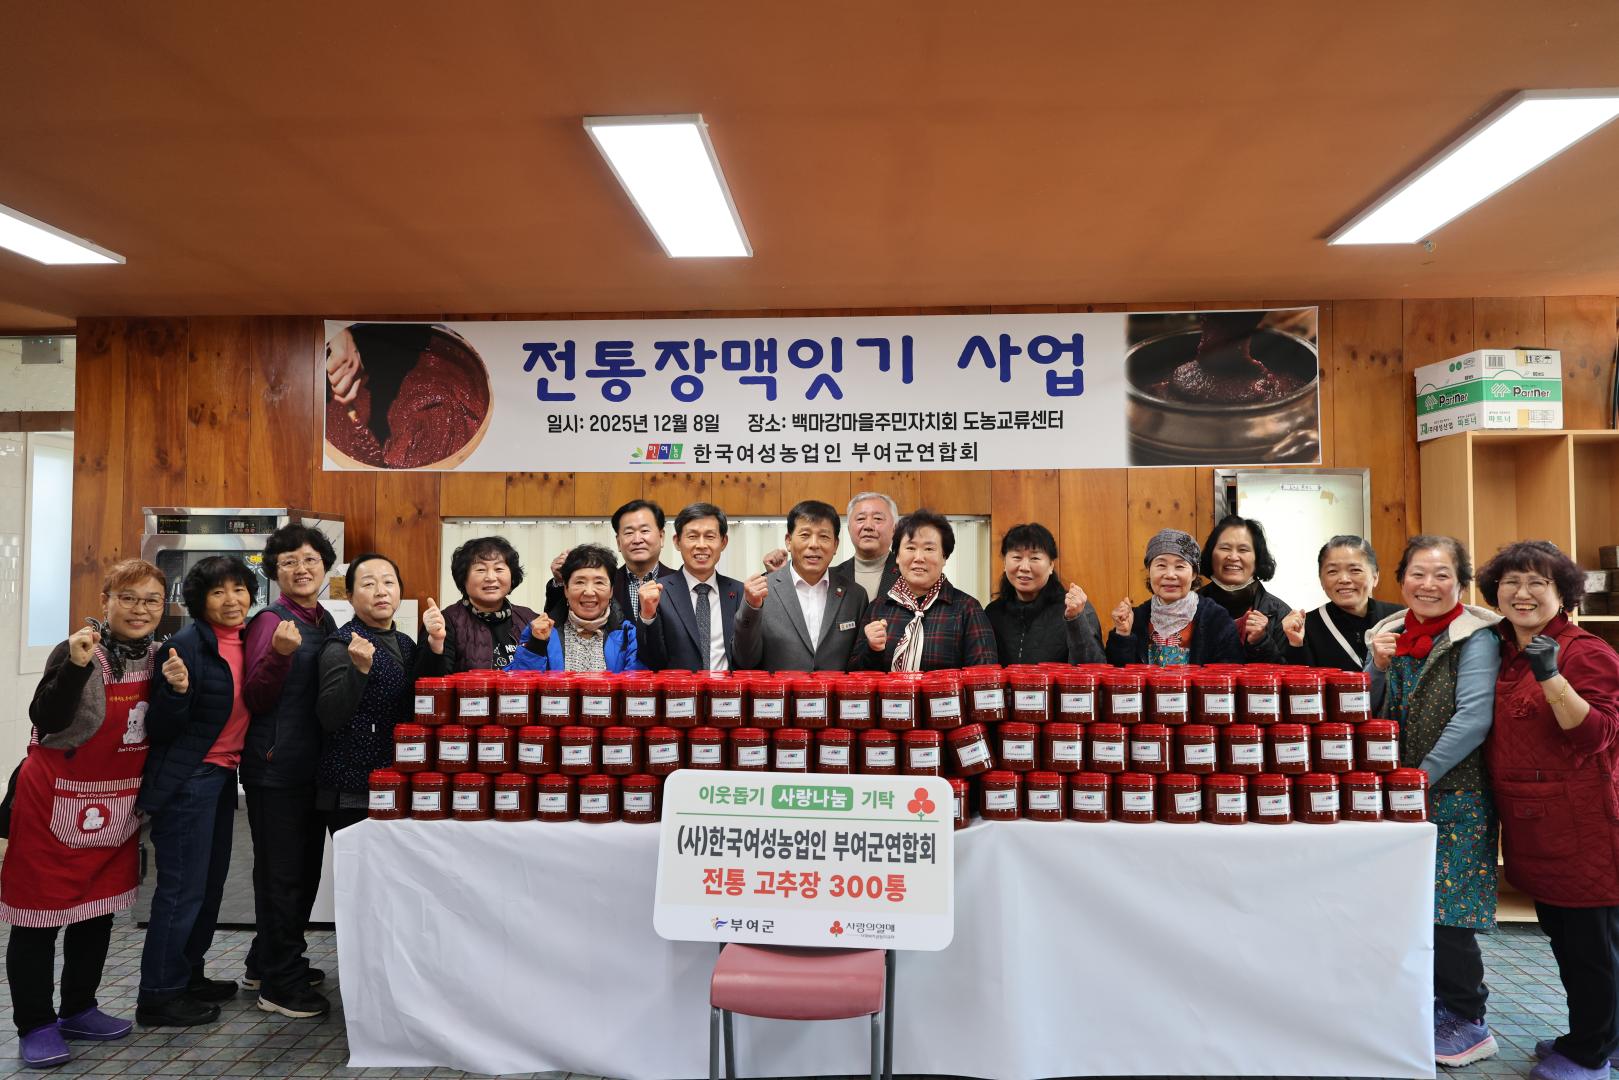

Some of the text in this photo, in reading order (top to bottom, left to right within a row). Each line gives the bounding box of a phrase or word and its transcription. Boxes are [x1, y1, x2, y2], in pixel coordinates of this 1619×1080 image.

[523, 333, 1084, 402] 전통장맥잇기 사업
[547, 414, 720, 433] 일시: 2025년 12월 8일
[748, 409, 1064, 433] 장소: 백마강마을주민자치회 도농교류센터
[693, 441, 978, 464] 한국여성농업인 부여군연합회
[699, 785, 895, 809] 이웃돕기 사랑나눔 기탁
[677, 825, 936, 864] (사)한국여성농업인 부여군연합회
[702, 867, 907, 903] 전통 고추장 300통
[730, 918, 775, 934] 부여군
[846, 922, 895, 934] 사랑의열매
